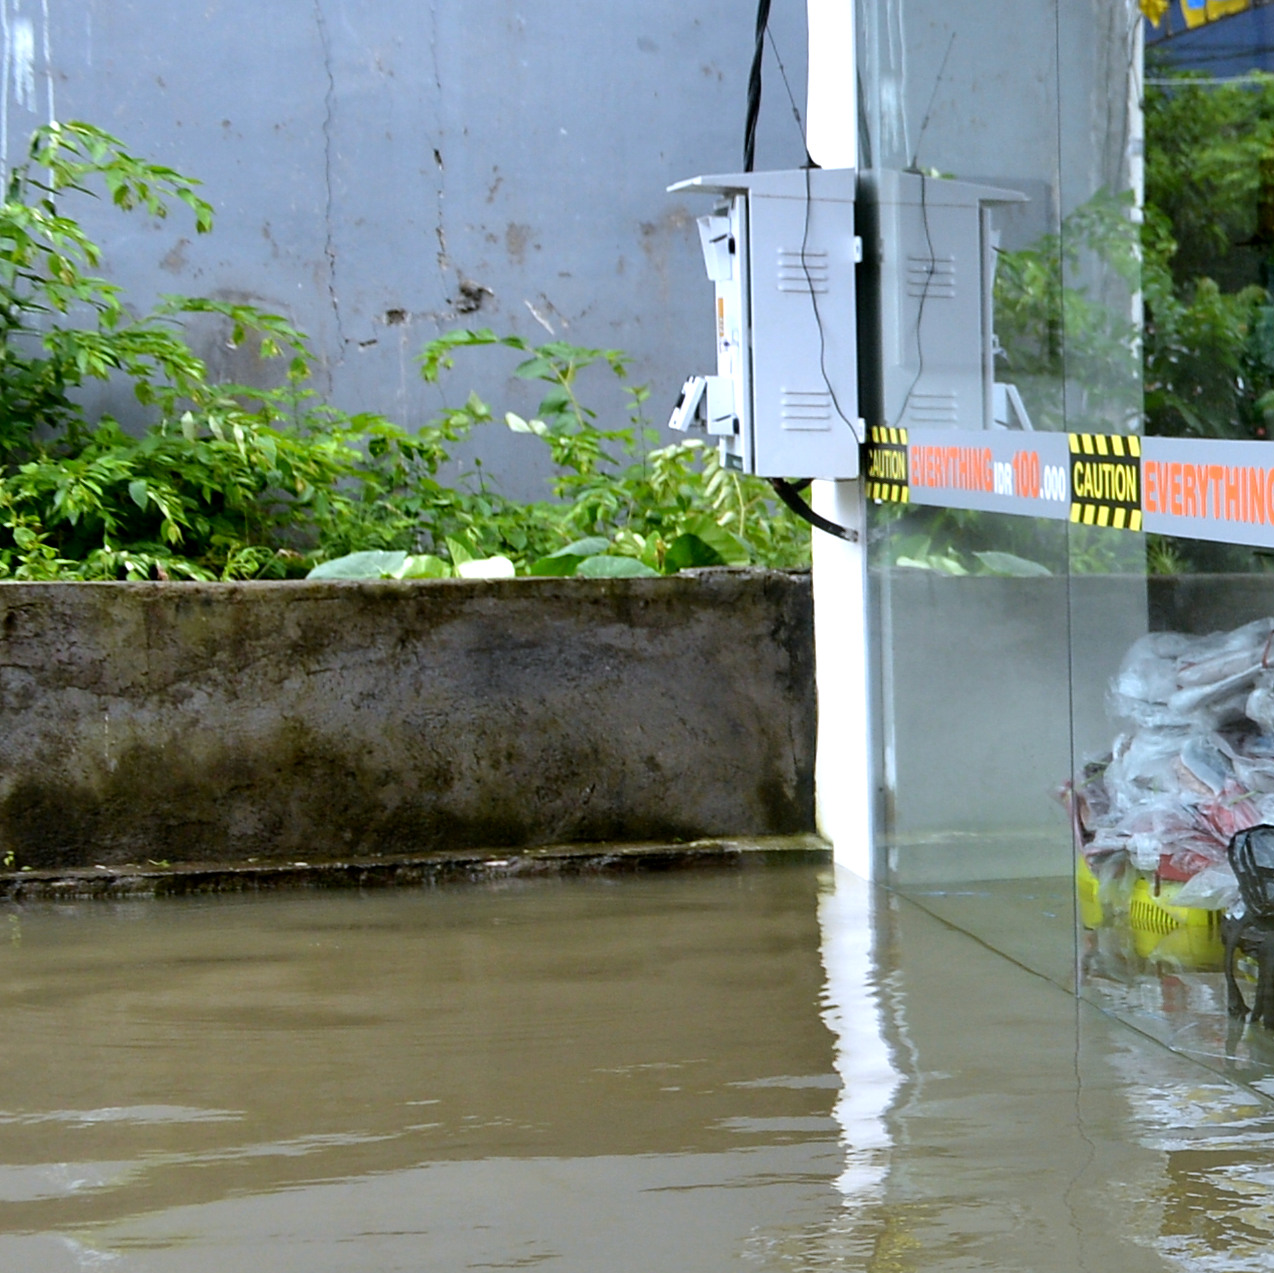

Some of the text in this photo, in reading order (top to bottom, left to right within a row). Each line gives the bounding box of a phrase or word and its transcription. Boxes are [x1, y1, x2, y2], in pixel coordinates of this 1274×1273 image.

[911, 446, 993, 493] EVERYTHING
[994, 461, 1013, 496] IDR
[1074, 461, 1137, 502] CAUTION
